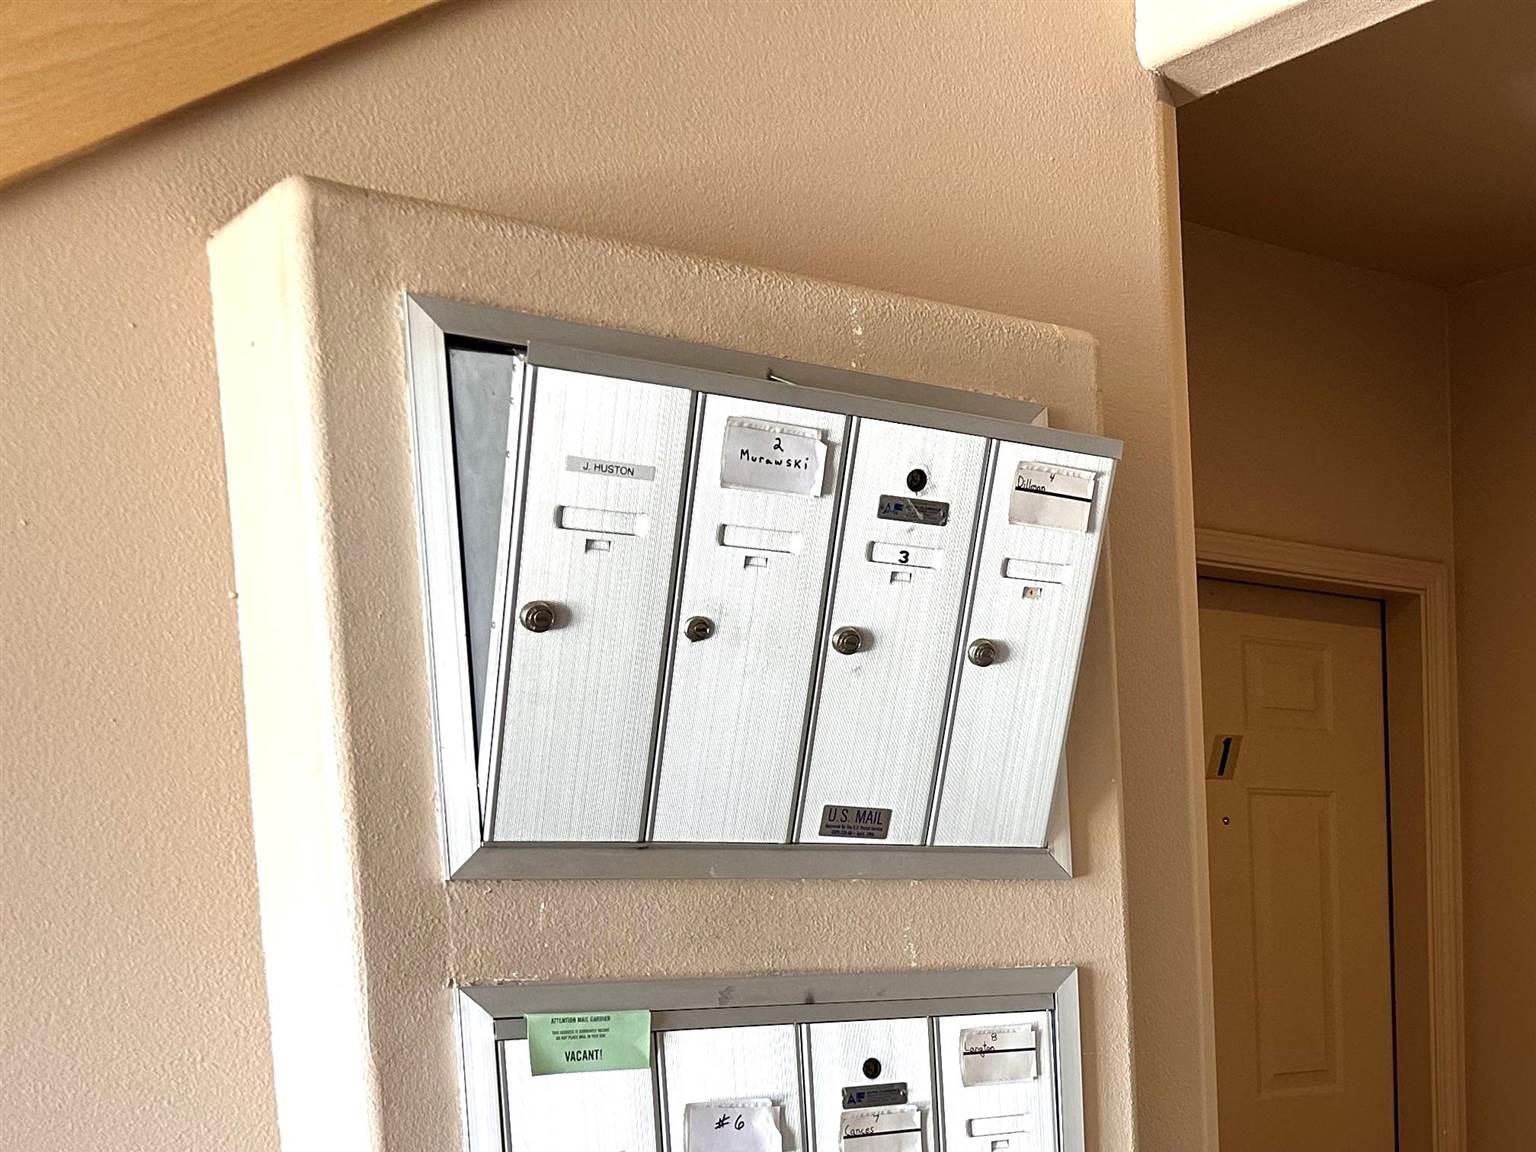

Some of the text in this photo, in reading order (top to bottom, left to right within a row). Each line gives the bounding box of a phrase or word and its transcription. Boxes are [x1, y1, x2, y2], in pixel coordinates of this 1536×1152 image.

[772, 437, 784, 452] 2
[594, 464, 634, 476] HUSTON
[898, 550, 910, 563] 3
[1216, 737, 1232, 776] 1
[855, 810, 883, 825] MAIL
[990, 1032, 998, 1041] 8
[565, 1048, 603, 1062] VACANT!
